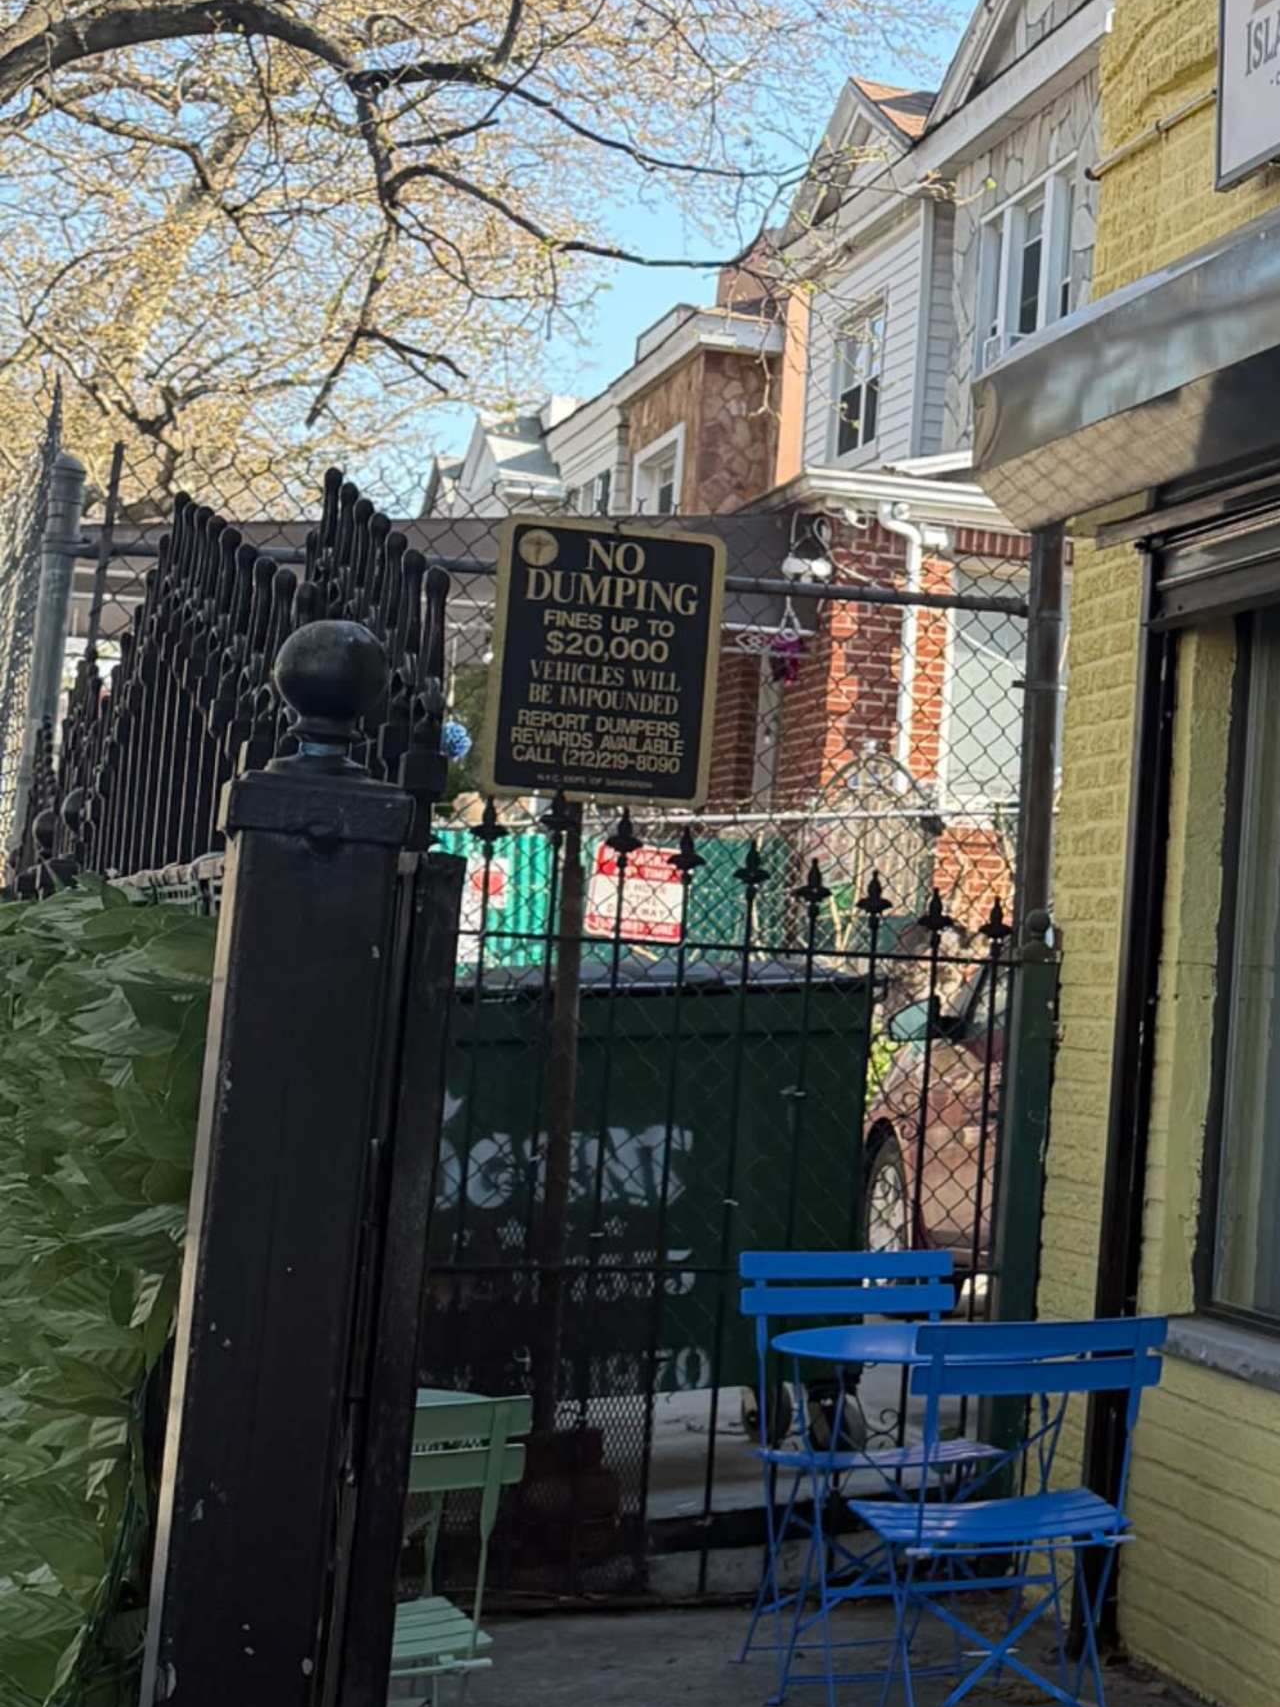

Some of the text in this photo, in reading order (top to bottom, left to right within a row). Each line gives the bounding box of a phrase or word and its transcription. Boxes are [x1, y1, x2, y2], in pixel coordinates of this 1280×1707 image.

[585, 538, 646, 575] NO
[525, 567, 699, 616] DUMPING
[543, 609, 675, 638] FINES UP TO
[545, 630, 669, 663] $20,000
[530, 659, 682, 693] VEHICLES WILL
[528, 683, 679, 716] BE IMPOUNDED
[517, 709, 680, 739] REPORT DUMPERS
[511, 727, 684, 757] REWARDS AVAILABLE
[512, 745, 681, 774] CALL (212)219-8090
